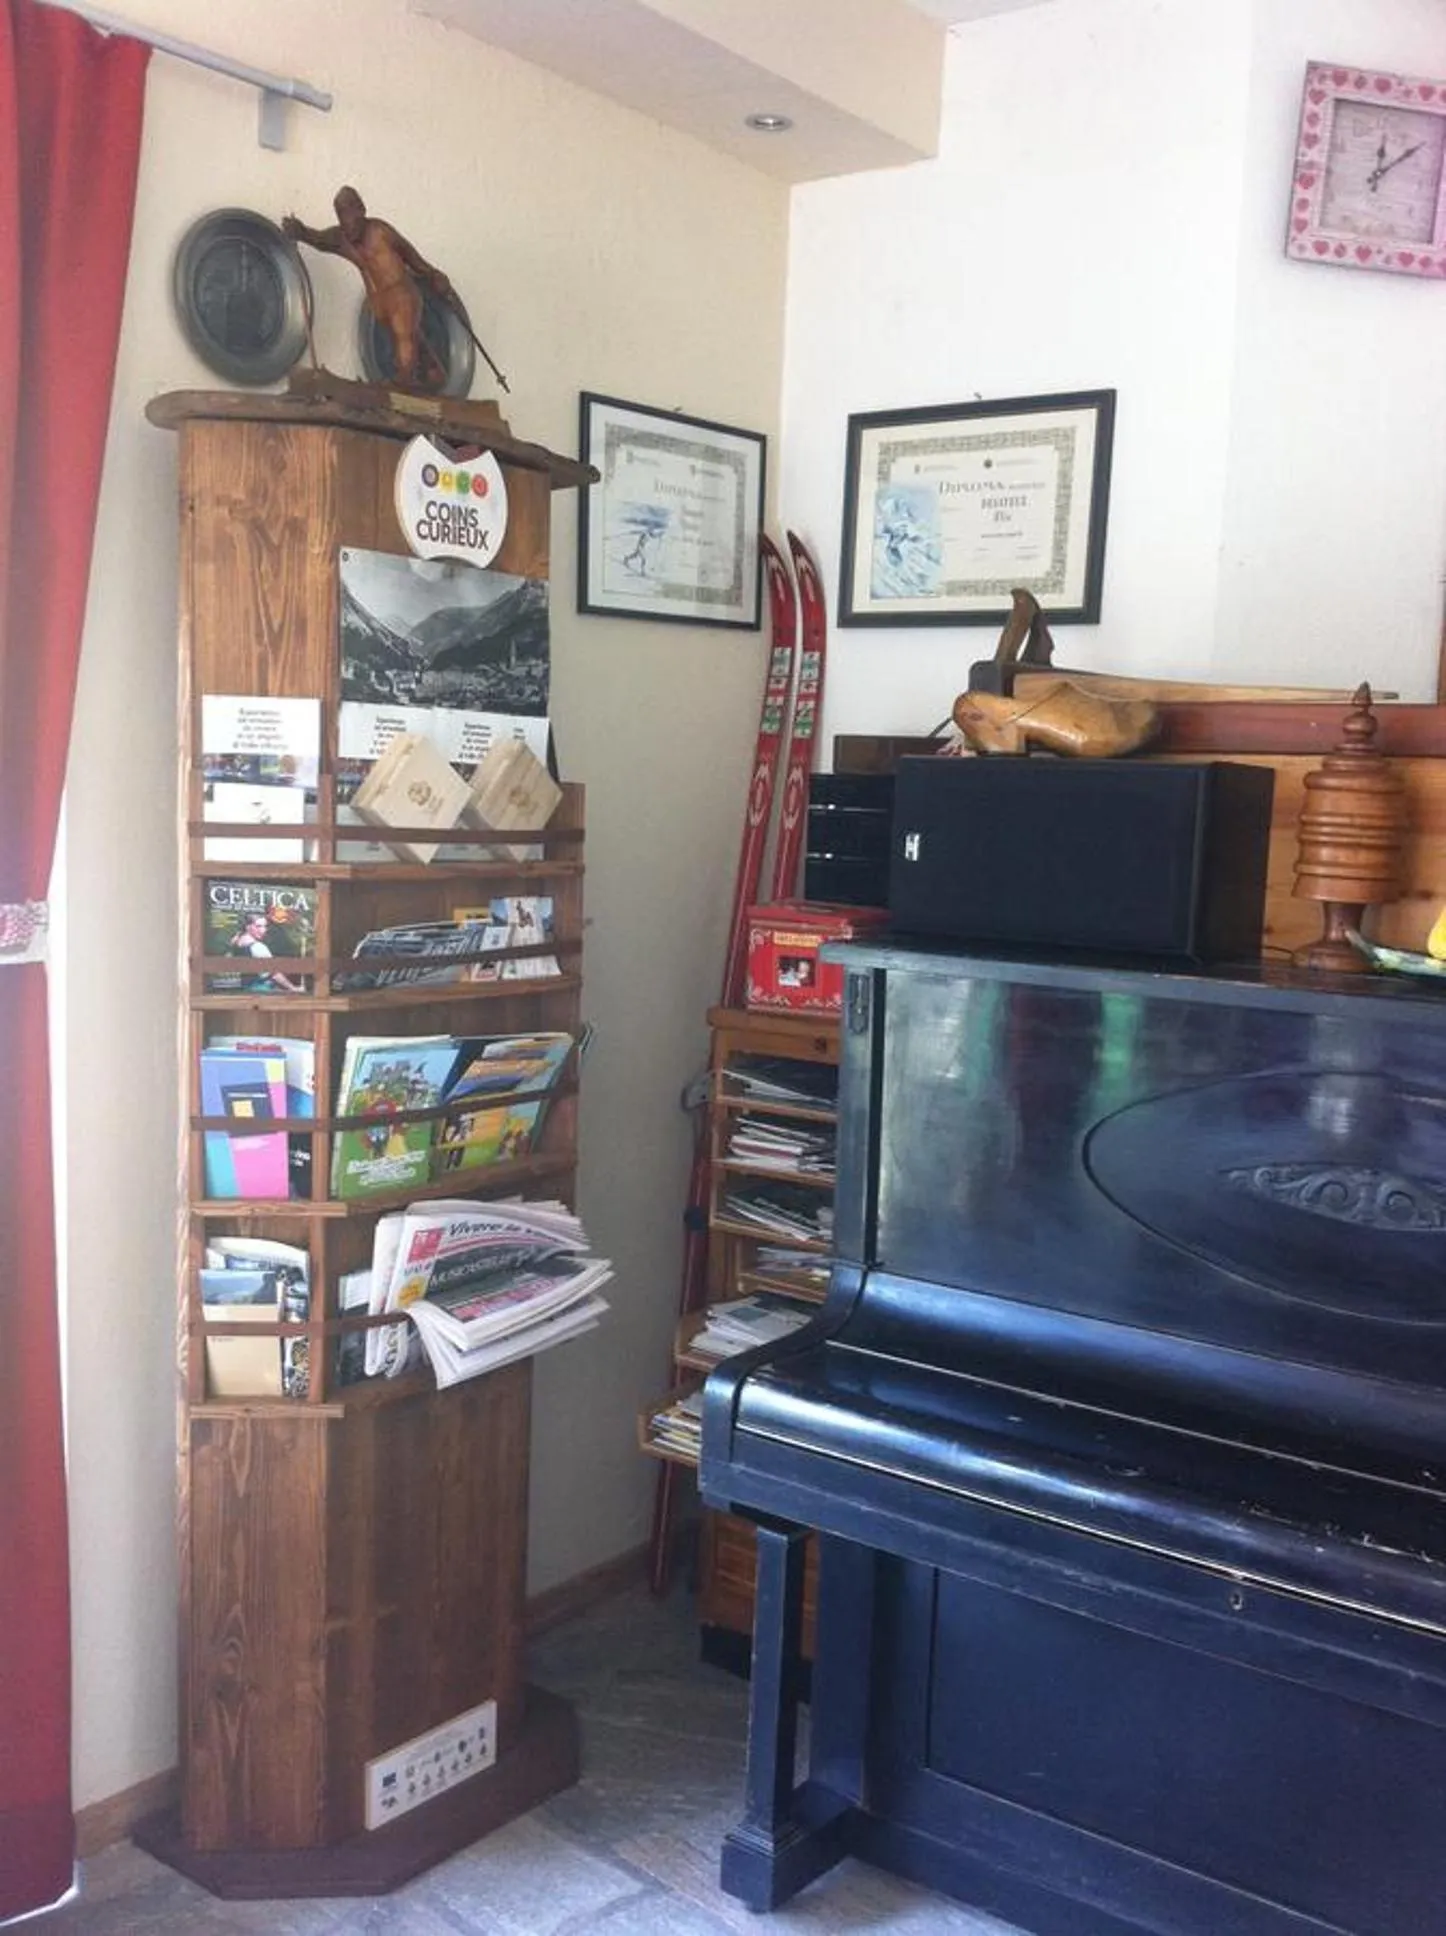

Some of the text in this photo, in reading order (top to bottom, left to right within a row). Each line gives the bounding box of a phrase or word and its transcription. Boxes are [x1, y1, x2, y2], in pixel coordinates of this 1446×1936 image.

[426, 501, 479, 528] COINS
[416, 520, 490, 550] CURIEUX
[210, 886, 310, 911] CELTICA
